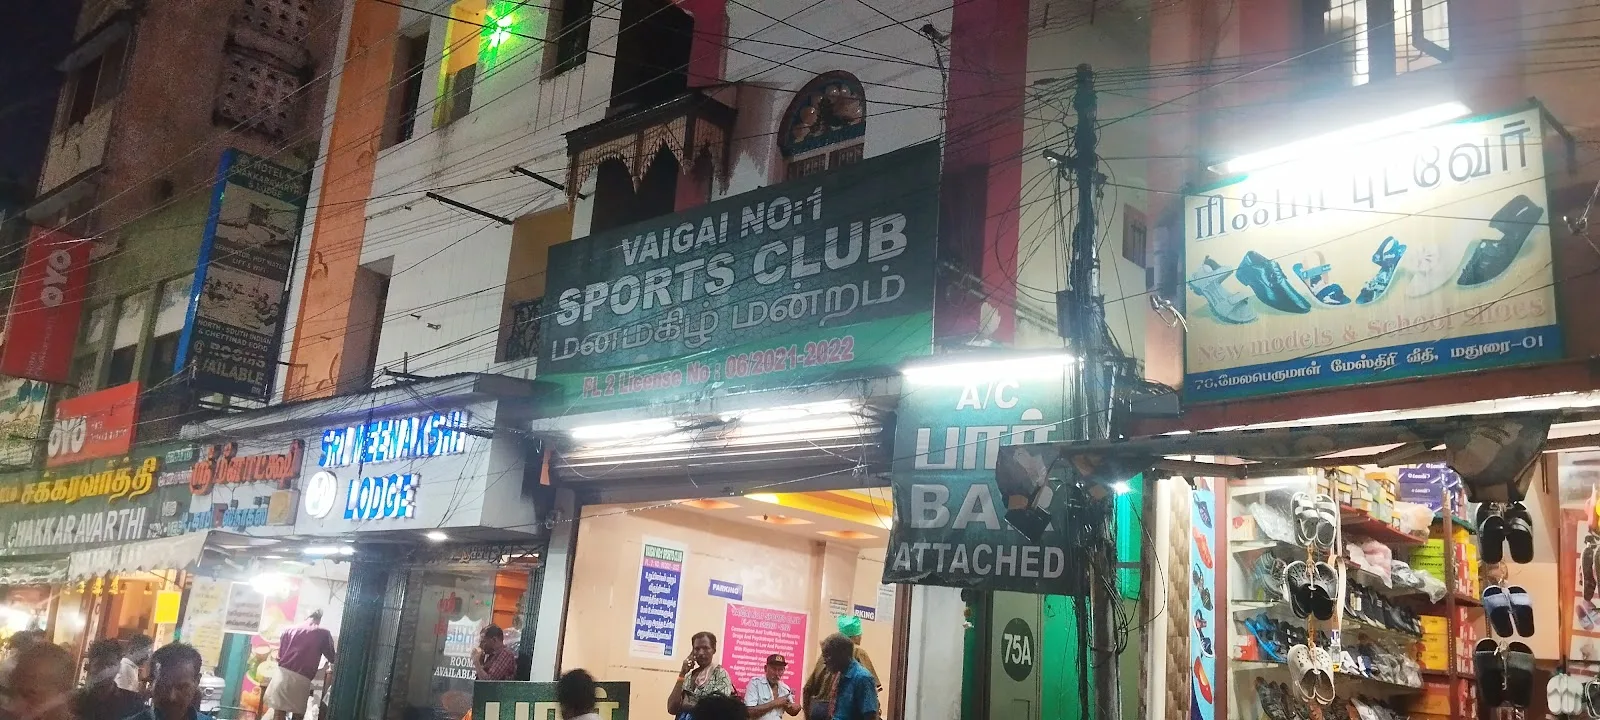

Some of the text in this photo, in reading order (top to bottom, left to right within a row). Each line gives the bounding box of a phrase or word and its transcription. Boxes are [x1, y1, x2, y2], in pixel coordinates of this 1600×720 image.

[622, 187, 823, 267] VAIGAI NO:1
[41, 249, 72, 307] OYO
[556, 213, 907, 327] SPORTS CLUB
[226, 326, 249, 339] SOUTH
[551, 264, 906, 363] மனமகிழ் மன்றம்
[205, 329, 247, 346] CHETTINAD
[1198, 342, 1246, 364] New
[1251, 326, 1334, 357] models
[1342, 323, 1358, 342] &
[604, 373, 616, 396] 2
[618, 367, 683, 395] License
[686, 361, 711, 385] No
[725, 335, 855, 379] 06/2021-2022
[956, 382, 1021, 410] A/C
[48, 415, 87, 458] OYO
[319, 411, 467, 468] SRI MEENAKSHI
[344, 474, 420, 520] LODGE
[892, 541, 1065, 579] ATTACHED
[712, 583, 739, 595] PARKING
[449, 655, 476, 669] ROOM
[1003, 633, 1032, 666] 75A
[433, 666, 477, 681] AVAILABLE
